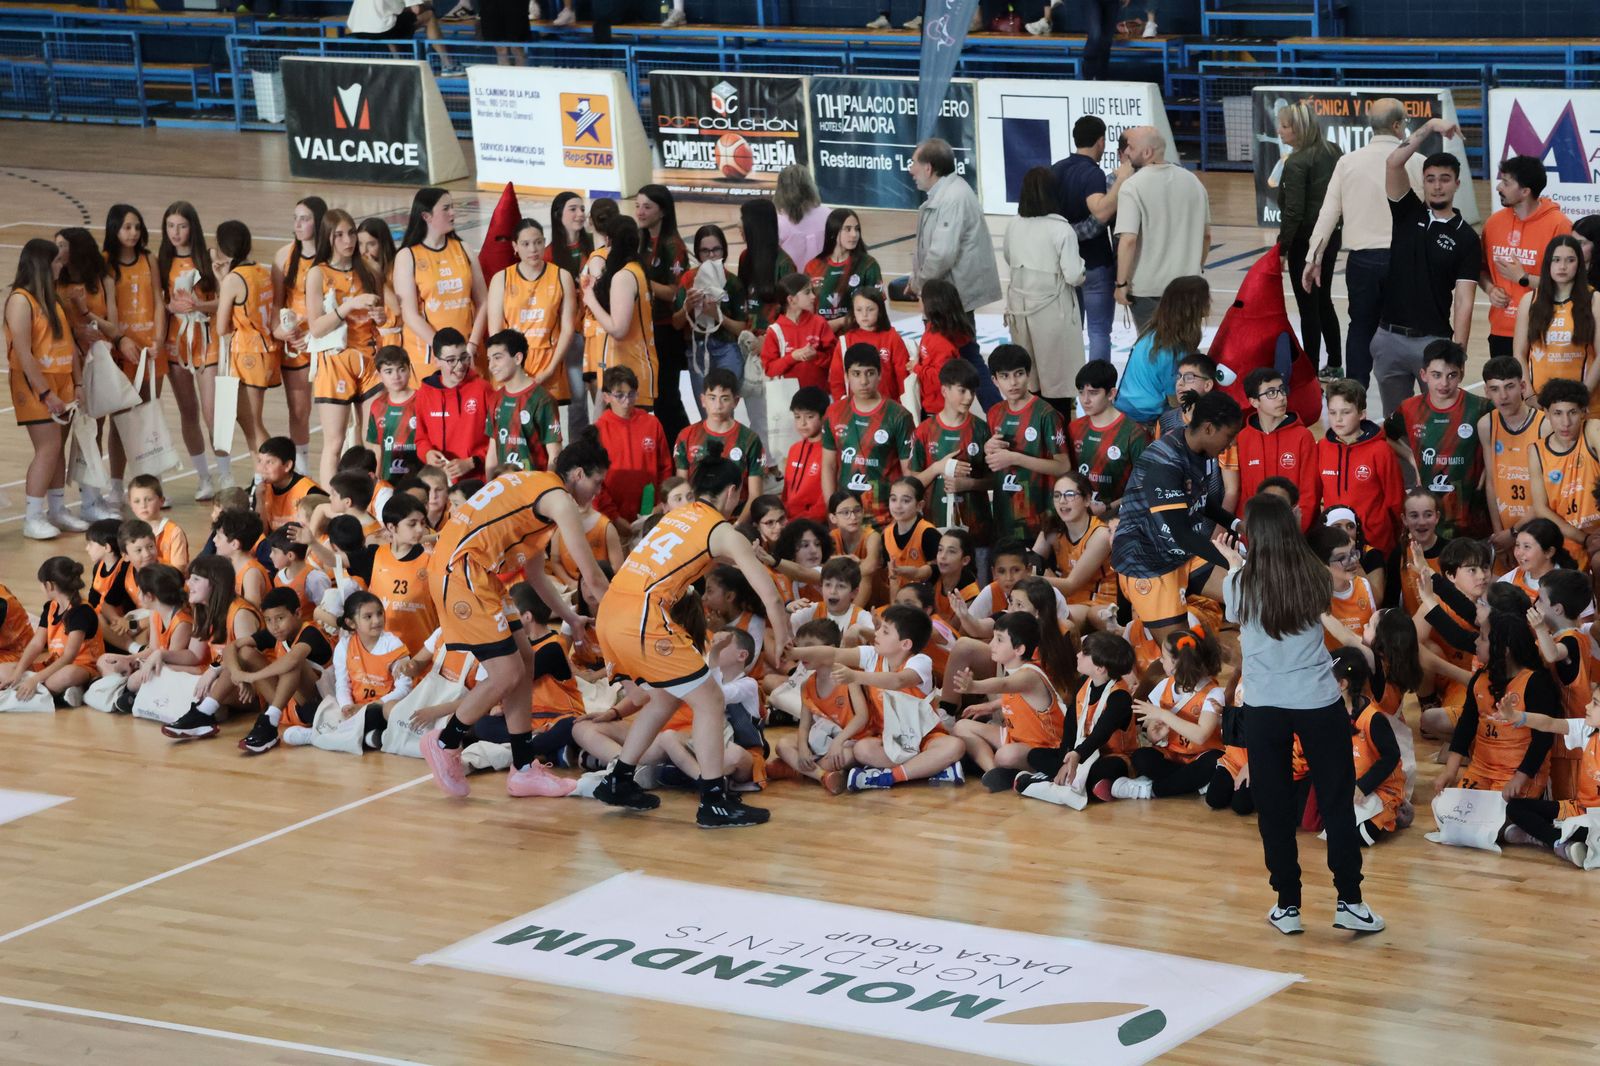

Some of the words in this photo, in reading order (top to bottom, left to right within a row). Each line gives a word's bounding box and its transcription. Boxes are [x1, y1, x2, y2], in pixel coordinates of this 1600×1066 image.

[844, 94, 895, 114] PALACIO
[1082, 97, 1106, 115] LUIS
[1109, 97, 1142, 116] FELIPE
[1354, 99, 1361, 116] Y
[658, 115, 799, 131] DORCOLCHÓN
[819, 121, 842, 132] HOTELS
[844, 117, 896, 134] ZAMORA
[294, 135, 420, 167] VALCARCE
[480, 142, 504, 152] SERVICIO
[663, 140, 716, 161] COMPITE
[752, 140, 797, 165] SUEÑA
[820, 149, 892, 170] Restaurante
[1552, 193, 1581, 202] Cruces
[1584, 194, 1593, 202] 17
[465, 480, 505, 511] 8
[1511, 484, 1526, 500] 33
[392, 579, 409, 595] 23
[1485, 723, 1499, 739] 34
[823, 930, 944, 955] GROUP
[665, 924, 1045, 994] INGREDIENTS
[956, 947, 1074, 976] DACSA
[492, 923, 1007, 1021] MOLENDUM
